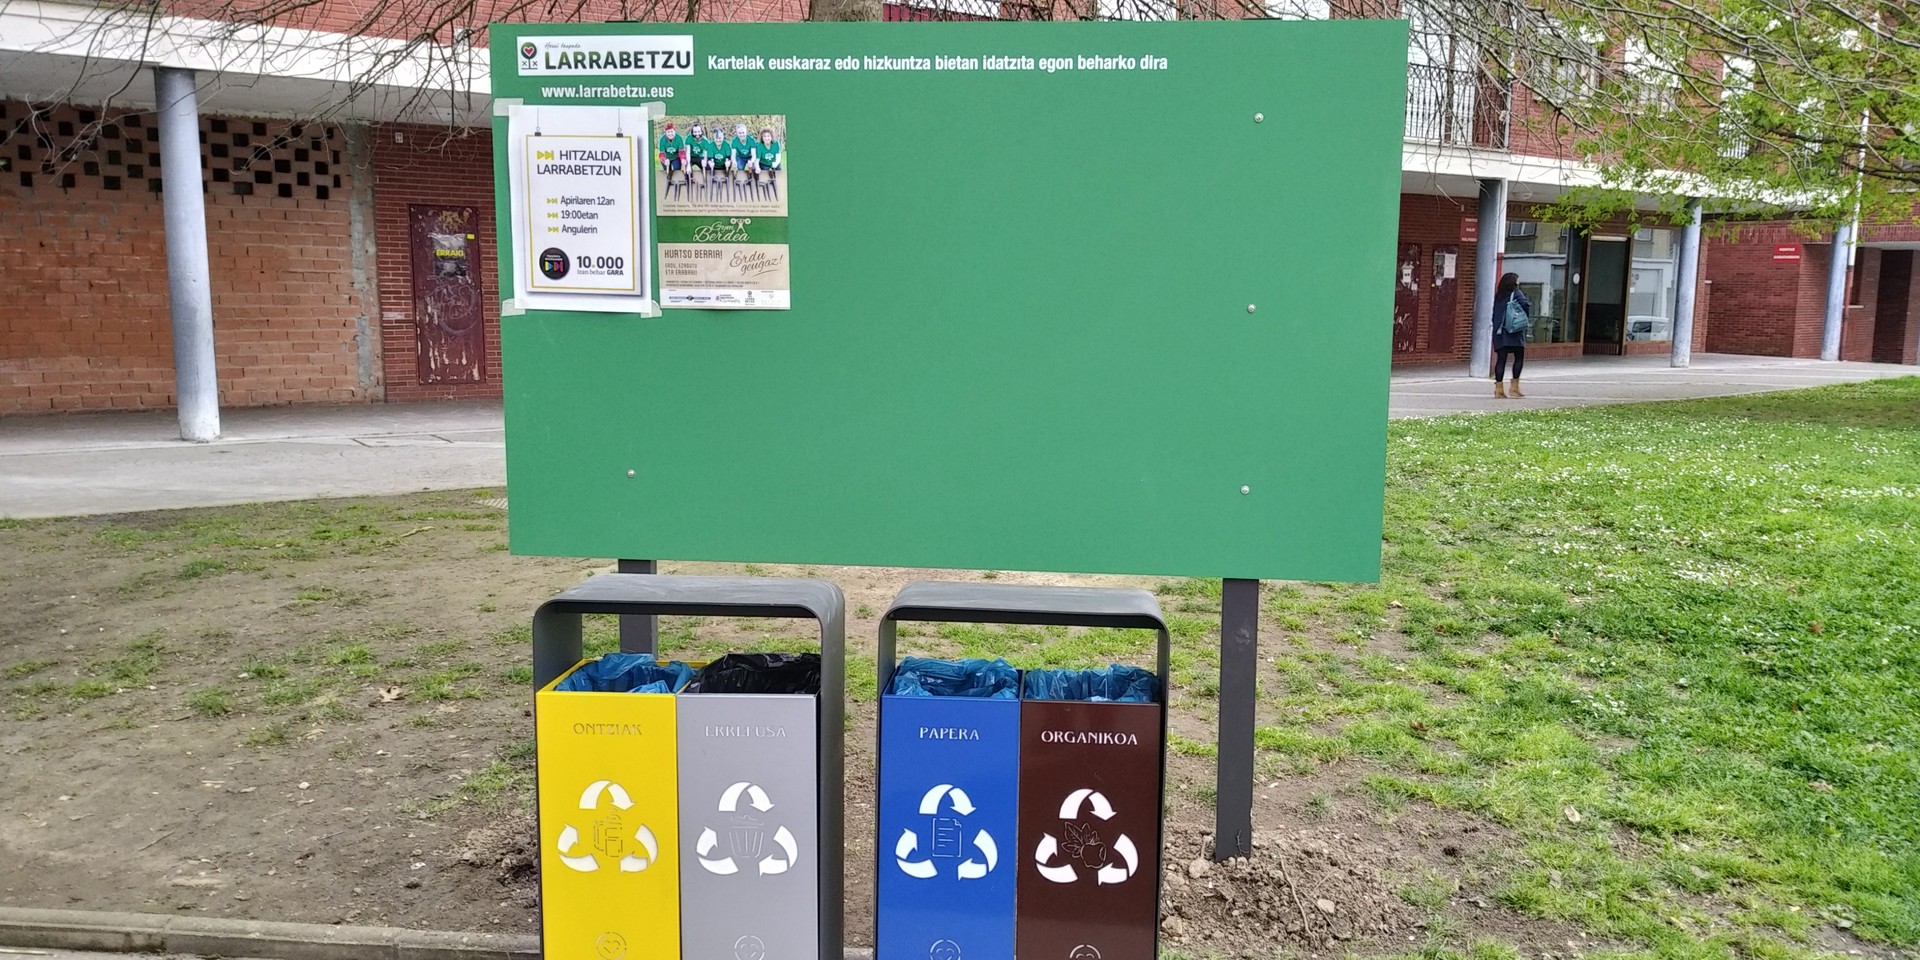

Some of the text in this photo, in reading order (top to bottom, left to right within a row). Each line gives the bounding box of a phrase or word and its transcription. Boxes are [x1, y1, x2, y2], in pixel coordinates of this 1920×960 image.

[544, 50, 691, 70] LARRABETZU
[707, 55, 765, 70] Kartelak
[768, 55, 831, 70] euskaraz
[834, 55, 860, 70] edo
[863, 55, 931, 70] hizkuntza
[935, 55, 979, 70] bietan
[1038, 57, 1074, 73] egon
[1077, 55, 1136, 70] beharko
[1139, 55, 1168, 70] dira
[541, 84, 675, 98] www.larrabetzu.eus
[559, 150, 622, 161] HITZALDIA
[536, 164, 622, 176] LARRABETZUN
[560, 196, 615, 206] Apirilaren 12an
[561, 210, 599, 219] 19:00etan
[561, 224, 598, 235] Angulerin
[693, 226, 750, 242] Berdea
[664, 249, 723, 260] KURTSO BERRIA!
[729, 250, 766, 267] Erdu
[576, 256, 624, 269] 10.000
[740, 254, 784, 277] geugaz!
[573, 722, 643, 736] ONTZIAK
[919, 726, 980, 741] PAPERA
[1040, 730, 1138, 746] ORGANIKOA
